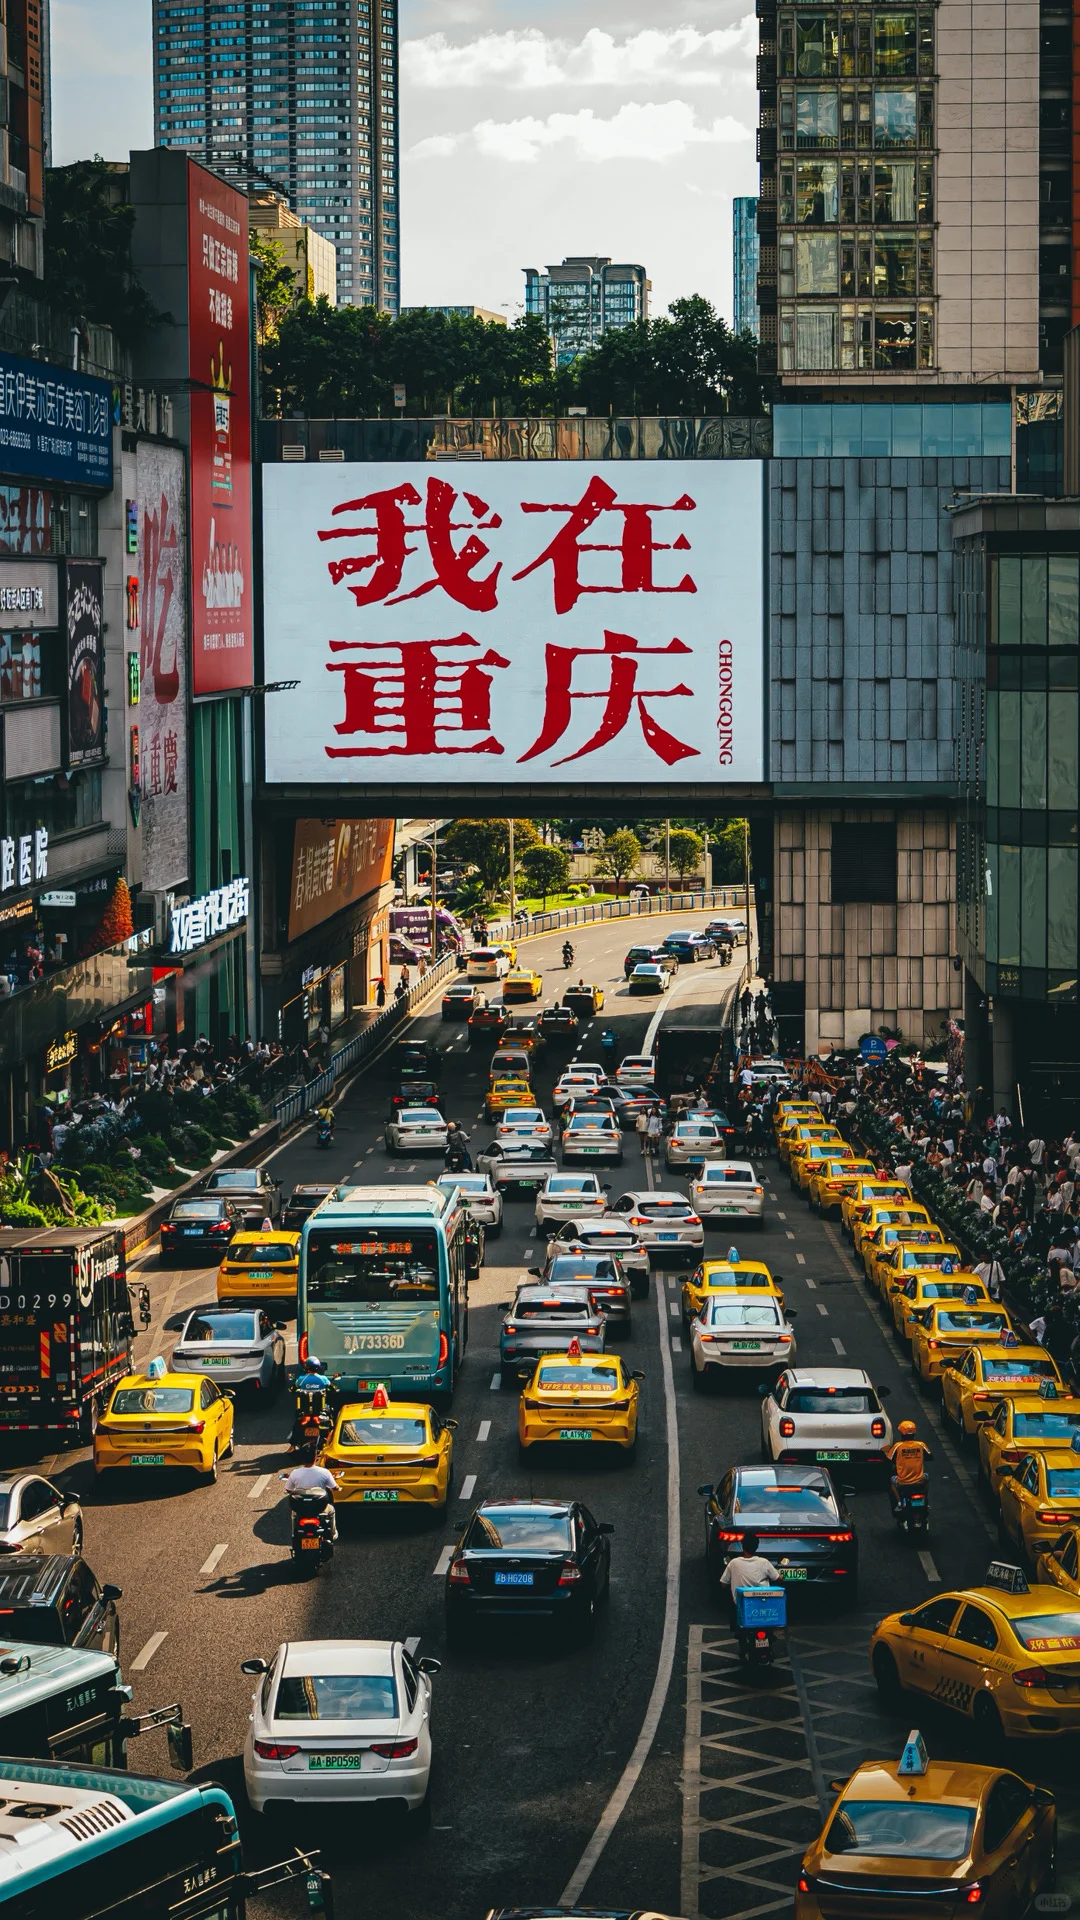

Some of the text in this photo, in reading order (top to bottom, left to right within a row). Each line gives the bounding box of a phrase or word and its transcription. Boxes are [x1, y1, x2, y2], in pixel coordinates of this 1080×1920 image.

[318, 476, 696, 614] 我在
[325, 630, 699, 765] 重庆
[717, 639, 732, 764] CHONGQING
[1, 827, 48, 891] 腔医院
[1030, 1637, 1080, 1652] 观音桥
